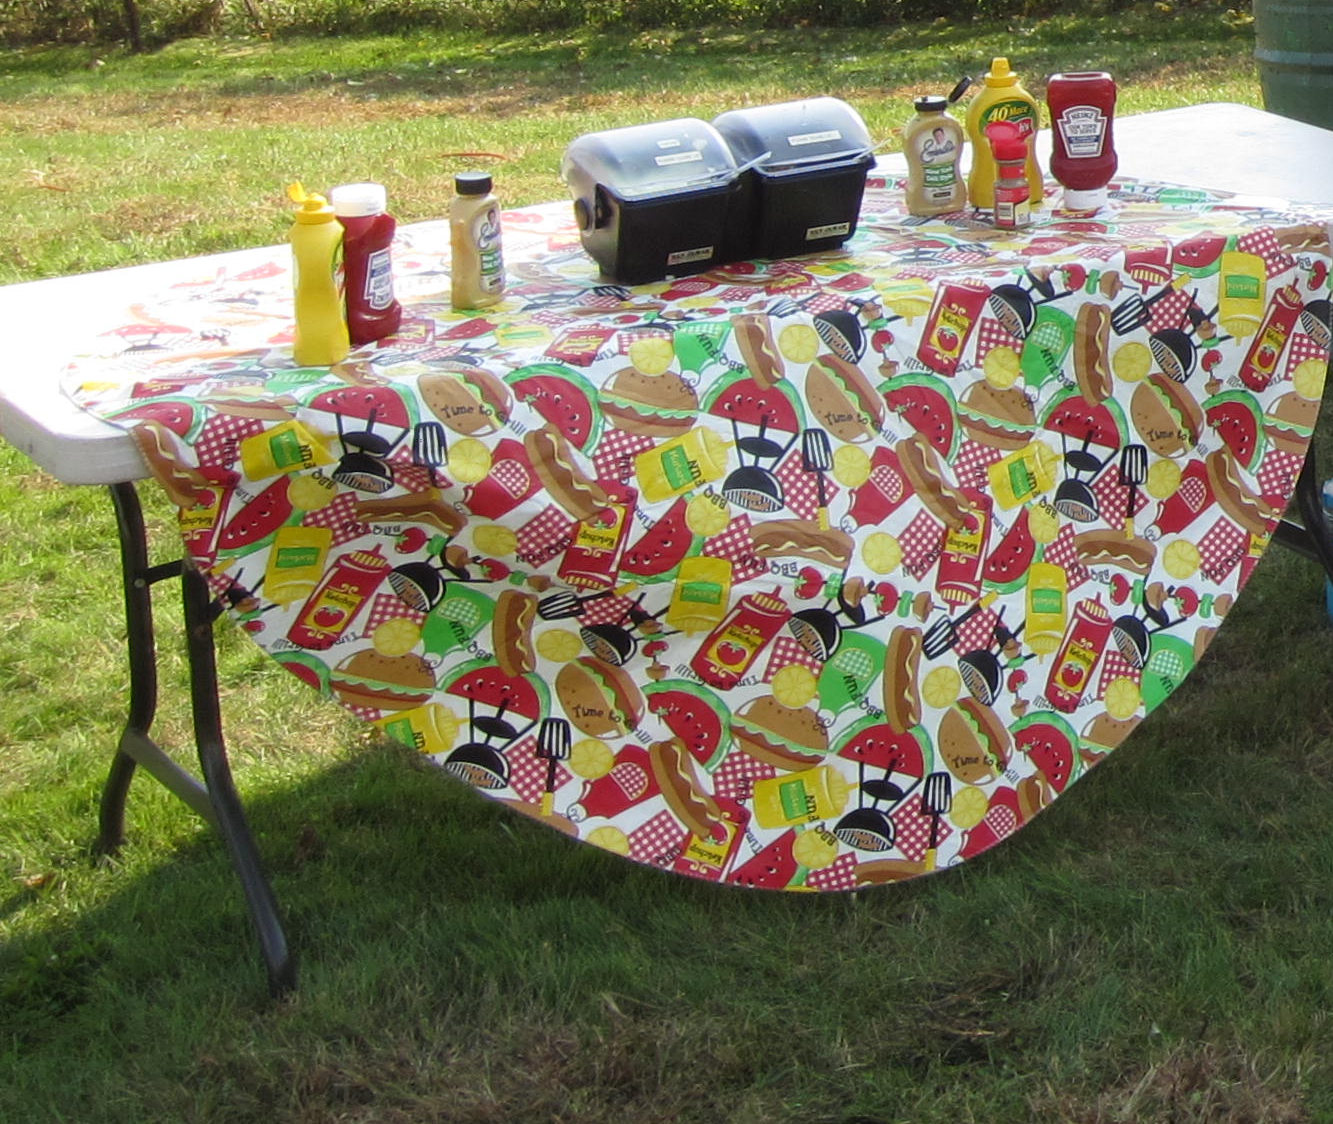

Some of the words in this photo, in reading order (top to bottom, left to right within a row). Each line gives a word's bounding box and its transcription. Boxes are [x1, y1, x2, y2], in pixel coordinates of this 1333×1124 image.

[441, 405, 475, 418] Time
[479, 404, 493, 416] to
[825, 412, 854, 425] Time
[703, 484, 729, 510] BBQ
[771, 560, 799, 576] BBQ
[467, 644, 493, 663] BBQ
[572, 704, 605, 717] Time
[608, 709, 622, 723] to
[858, 697, 884, 720] BBQ
[953, 755, 981, 767] Time
[815, 825, 837, 847] BBQ
